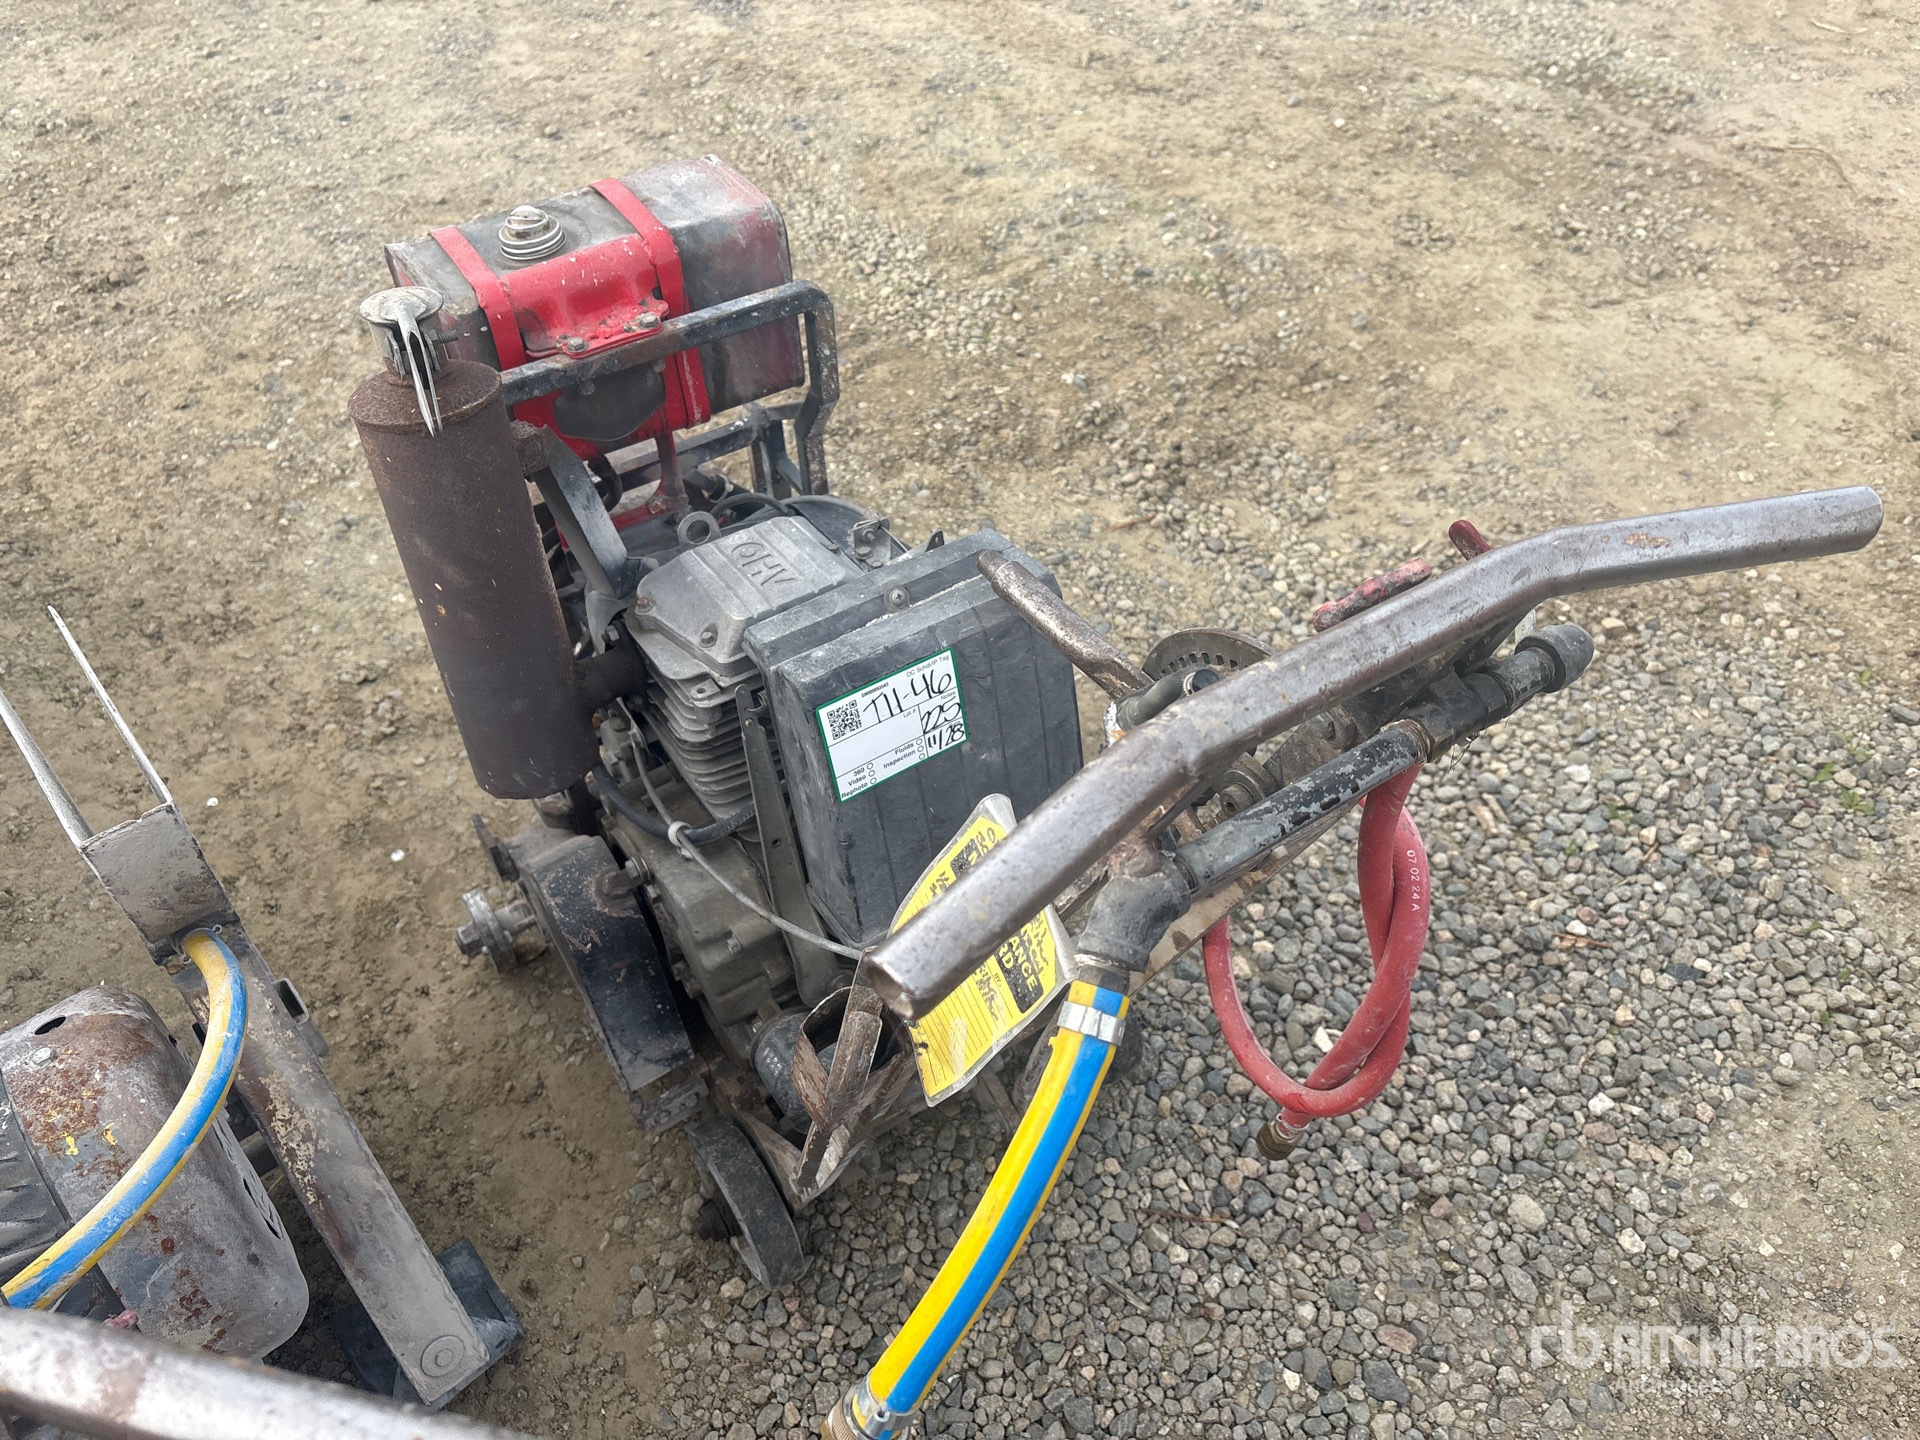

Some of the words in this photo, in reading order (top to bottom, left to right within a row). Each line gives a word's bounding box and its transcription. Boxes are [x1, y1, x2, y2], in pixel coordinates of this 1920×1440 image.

[731, 541, 798, 587] OHV
[939, 654, 950, 664] Tag
[940, 691, 956, 700] Notes
[920, 696, 961, 734] 225
[928, 723, 965, 750] 11/28
[894, 742, 914, 756] Fluids
[883, 749, 916, 769] Inspection
[853, 767, 865, 777] 360
[847, 775, 867, 787] Video
[841, 782, 868, 799] Rephoto
[1406, 850, 1417, 864] 07
[1410, 867, 1420, 881] 02
[1411, 885, 1420, 899] 24
[1411, 903, 1420, 912] A
